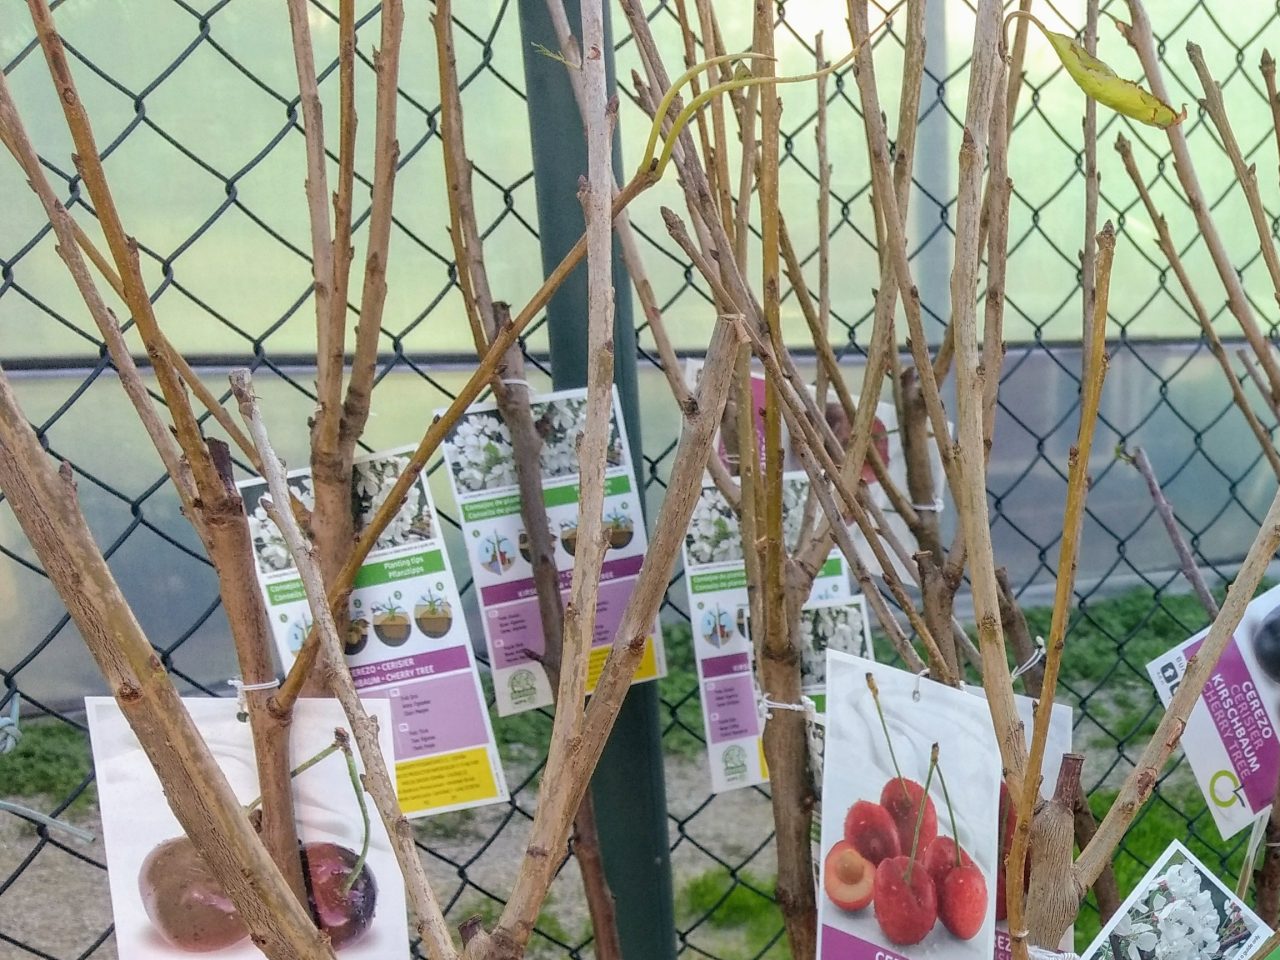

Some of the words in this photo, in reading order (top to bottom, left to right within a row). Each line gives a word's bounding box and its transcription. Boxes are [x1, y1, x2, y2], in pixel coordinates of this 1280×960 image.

[383, 558, 410, 571] Planting
[410, 555, 425, 566] tips
[350, 665, 376, 677] EREZO
[381, 657, 414, 671] CERISIER
[385, 668, 414, 682] CHERRY
[415, 664, 435, 676] TREE
[1199, 680, 1233, 742] CHERRY
[1228, 739, 1250, 786] TREE
[1209, 672, 1261, 777] KIRSCHBAUM
[1228, 682, 1265, 755] CERISIER
[1239, 678, 1273, 744] CEREZO
